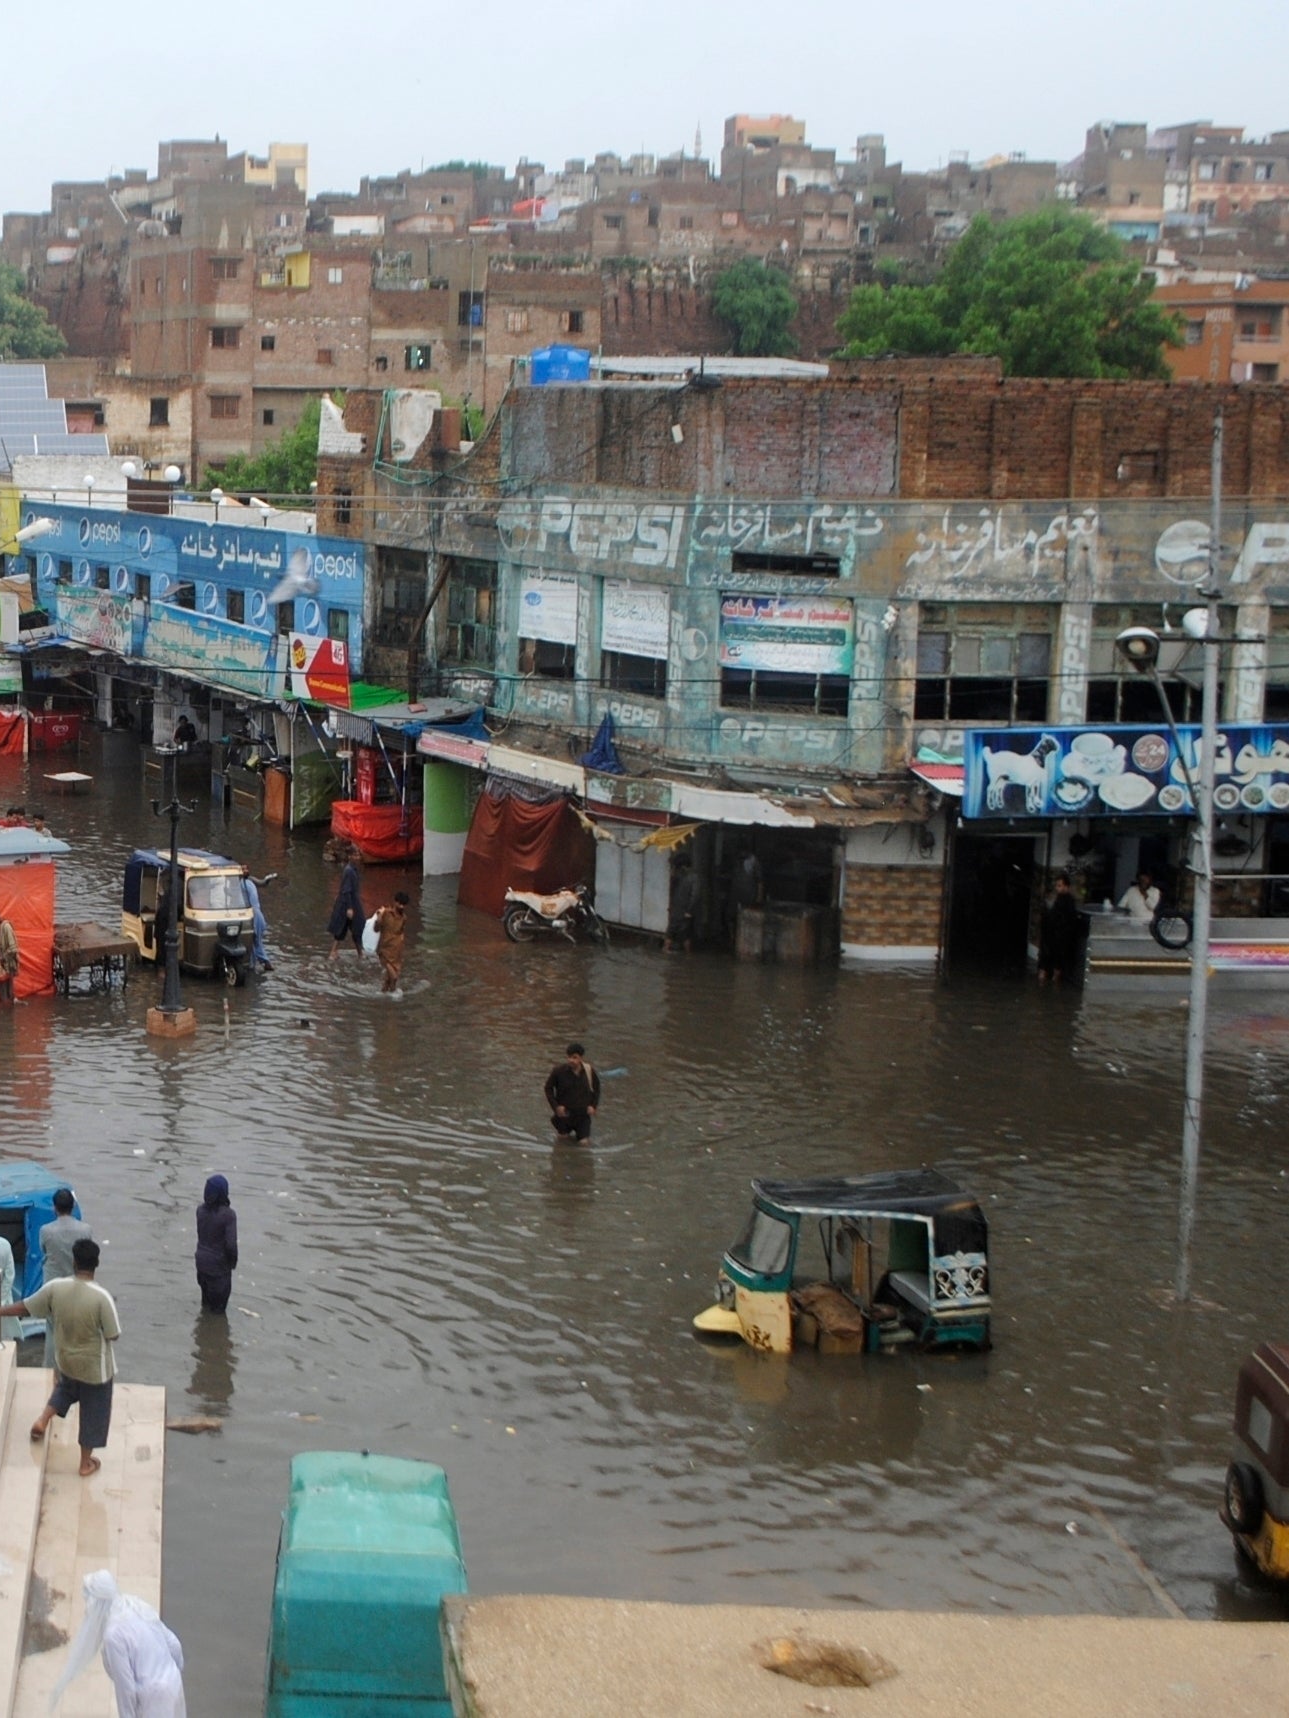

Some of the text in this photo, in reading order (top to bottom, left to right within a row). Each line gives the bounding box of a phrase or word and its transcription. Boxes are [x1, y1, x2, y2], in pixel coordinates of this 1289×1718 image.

[92, 521, 121, 547] pepsi
[536, 496, 686, 568] PEPSI
[314, 551, 357, 579] pepsi
[1061, 613, 1089, 715] PEPSI
[611, 701, 661, 728] PEPSI
[742, 721, 838, 749] PEPSI
[1149, 744, 1166, 756] 24
